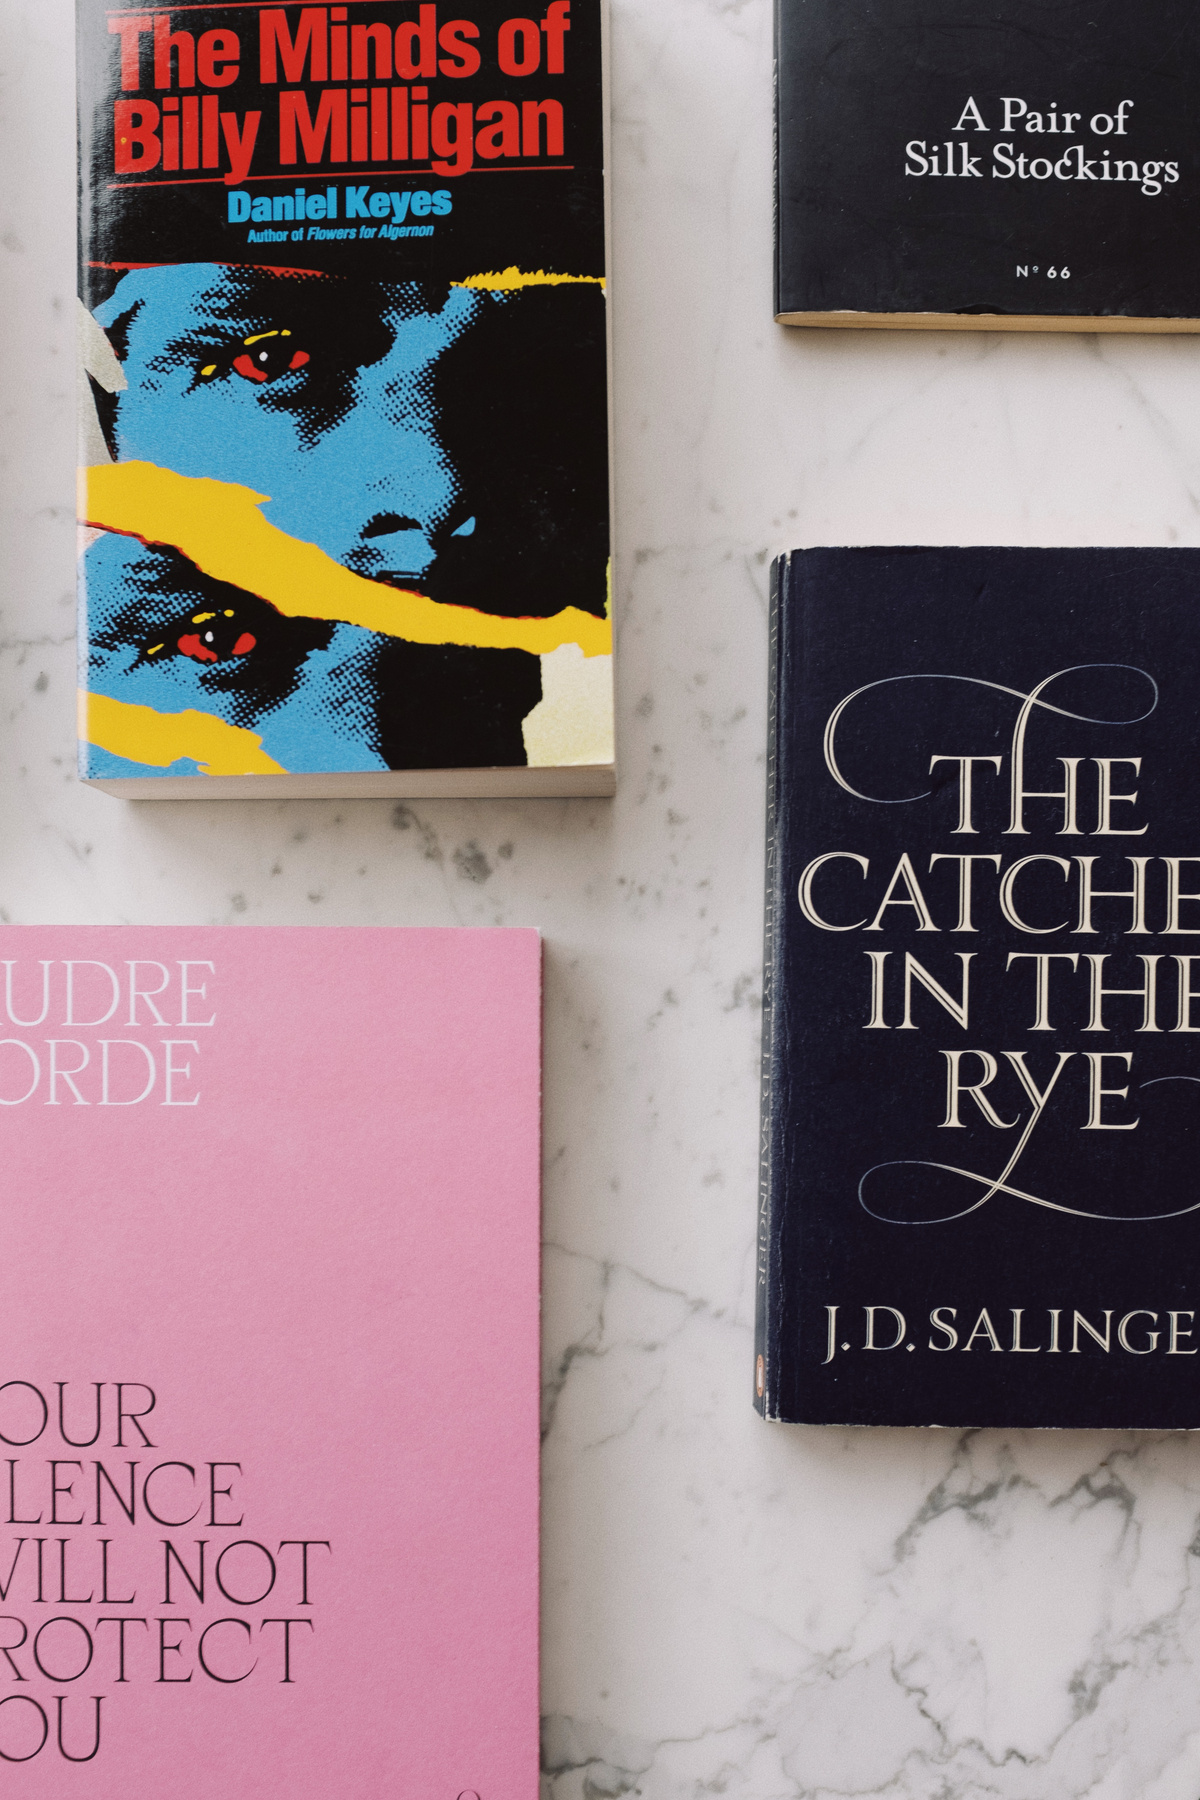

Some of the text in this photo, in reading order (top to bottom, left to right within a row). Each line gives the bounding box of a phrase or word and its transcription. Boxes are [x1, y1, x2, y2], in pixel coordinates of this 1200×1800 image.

[107, 1, 571, 91] The Minds of
[114, 86, 564, 185] Billy Milligan
[952, 96, 1134, 135] A Pair of
[905, 141, 1180, 196] Silk Stockings
[227, 186, 452, 226] Daniel Keyes
[247, 224, 434, 243] Author of Flowers for Algernon
[1046, 266, 1071, 280] 66
[798, 852, 1200, 934] CATCHE
[0, 961, 215, 1026] UDRE
[862, 951, 978, 1030] IN
[758, 1114, 769, 1288] SALINGER
[928, 1307, 1199, 1354] SALINGE
[0, 1381, 157, 1447] OUR
[5, 1460, 244, 1527] LENCE
[160, 1540, 331, 1605] NOT
[0, 1695, 106, 1762] OU
